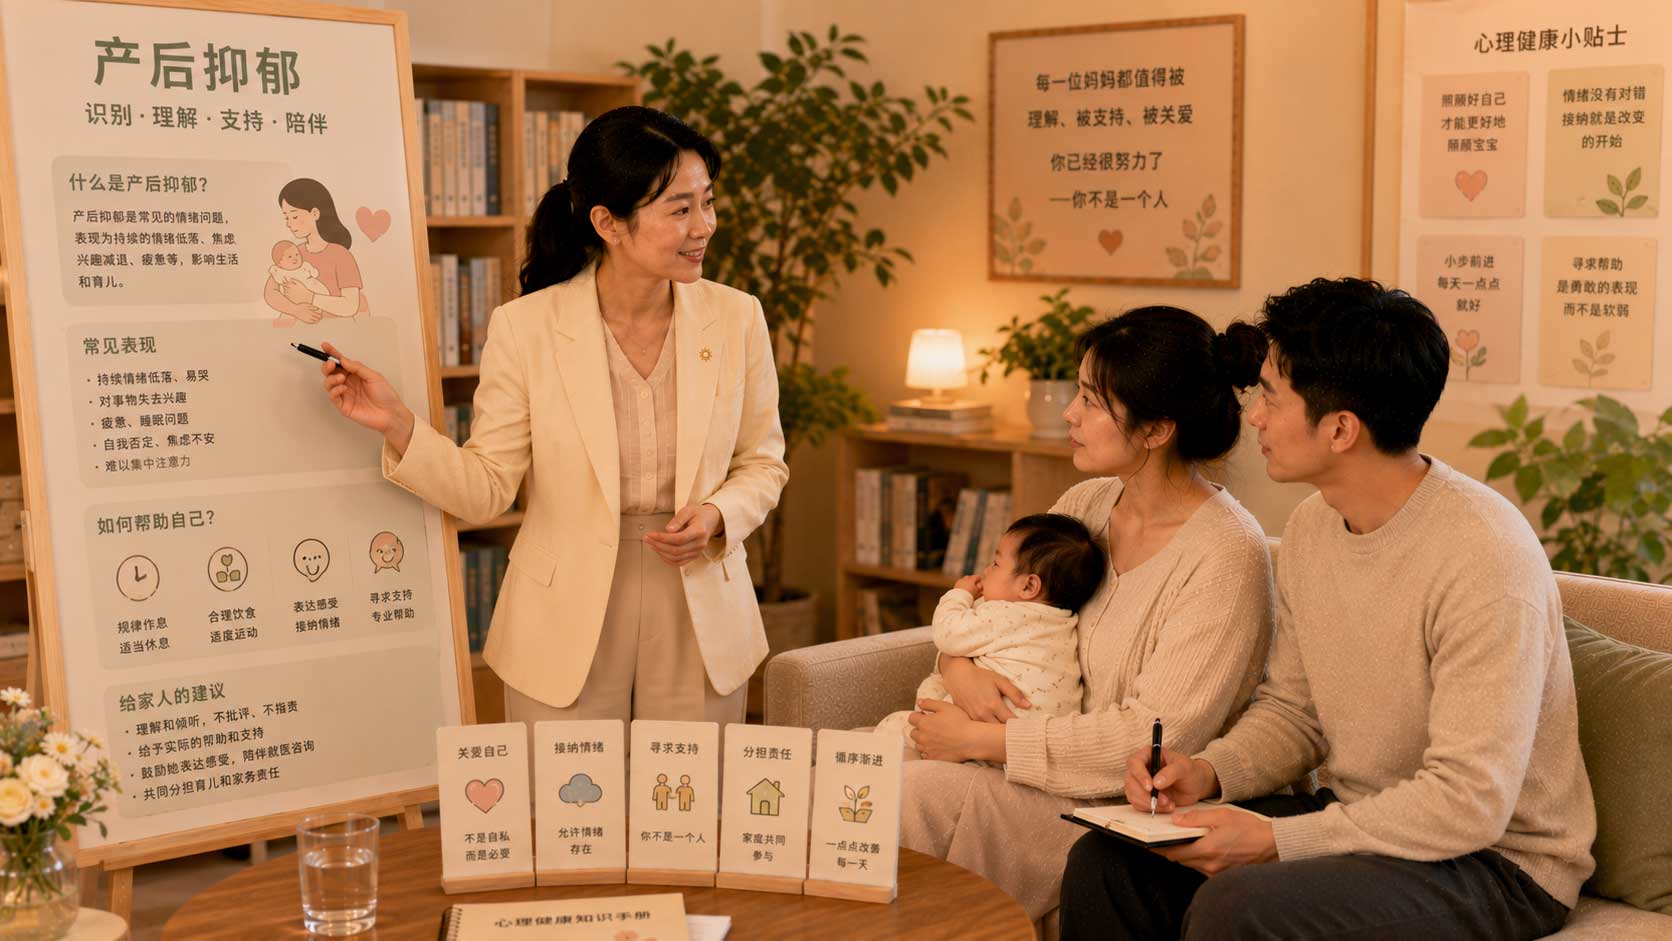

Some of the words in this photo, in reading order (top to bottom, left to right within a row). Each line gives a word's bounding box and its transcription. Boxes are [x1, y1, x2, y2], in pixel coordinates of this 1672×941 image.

[1474, 25, 1627, 52] 心理健康小贴士
[94, 36, 301, 95] 产后抑郁
[1036, 67, 1185, 91] 每一位妈妈都值得被
[1563, 86, 1646, 103] 情绪没有对错
[1028, 104, 1193, 128] 理解、被支持、被关爱
[1441, 115, 1506, 130] 才能更好地
[1562, 111, 1645, 127] 接纳就是改变
[1582, 135, 1622, 149] 的开始
[1051, 152, 1163, 171] 你已经很努力了
[69, 173, 208, 193] 什么是产后抑郁？
[75, 231, 235, 245] 表现为持续的情绪低落、焦虑
[1444, 255, 1494, 269] 小步前进
[1572, 258, 1623, 271] 寻求帮助
[78, 275, 126, 288] 和育儿。
[1437, 277, 1500, 291] 每天一点点
[1557, 281, 1638, 296] 是勇敢的表现
[1456, 299, 1481, 312] 就好
[1563, 303, 1629, 318] 而不是软弱
[83, 337, 156, 355] 常见表现
[97, 370, 209, 386] 持续情绪低落、易哭
[99, 392, 187, 408] 对事物失去兴趣
[103, 433, 215, 451] 自我否定、焦虑不安
[105, 456, 191, 472] 难以集中注意力
[97, 510, 215, 536] 如何帮助自己？
[370, 589, 413, 605] 寻求支持
[293, 598, 338, 614] 表达感受
[208, 607, 256, 624] 合理饮食
[371, 607, 414, 623] 专业帮助
[117, 617, 168, 634] 规律作息
[295, 617, 340, 633] 接纳情绪
[210, 627, 258, 644] 适度运动
[119, 682, 225, 713] 给家人的建议
[138, 727, 264, 757] 给予实际的帮助和支持
[554, 741, 604, 754] 接纳情绪
[649, 741, 699, 755] 寻求支持
[743, 746, 792, 761] 分担责任
[143, 766, 280, 801] 共同分担育儿和家务责任
[464, 833, 510, 844] 不是自私
[558, 827, 603, 839] 允许情绪
[640, 831, 706, 844] 你不是一个人
[570, 844, 591, 856] 存在
[837, 856, 868, 870] 每一天
